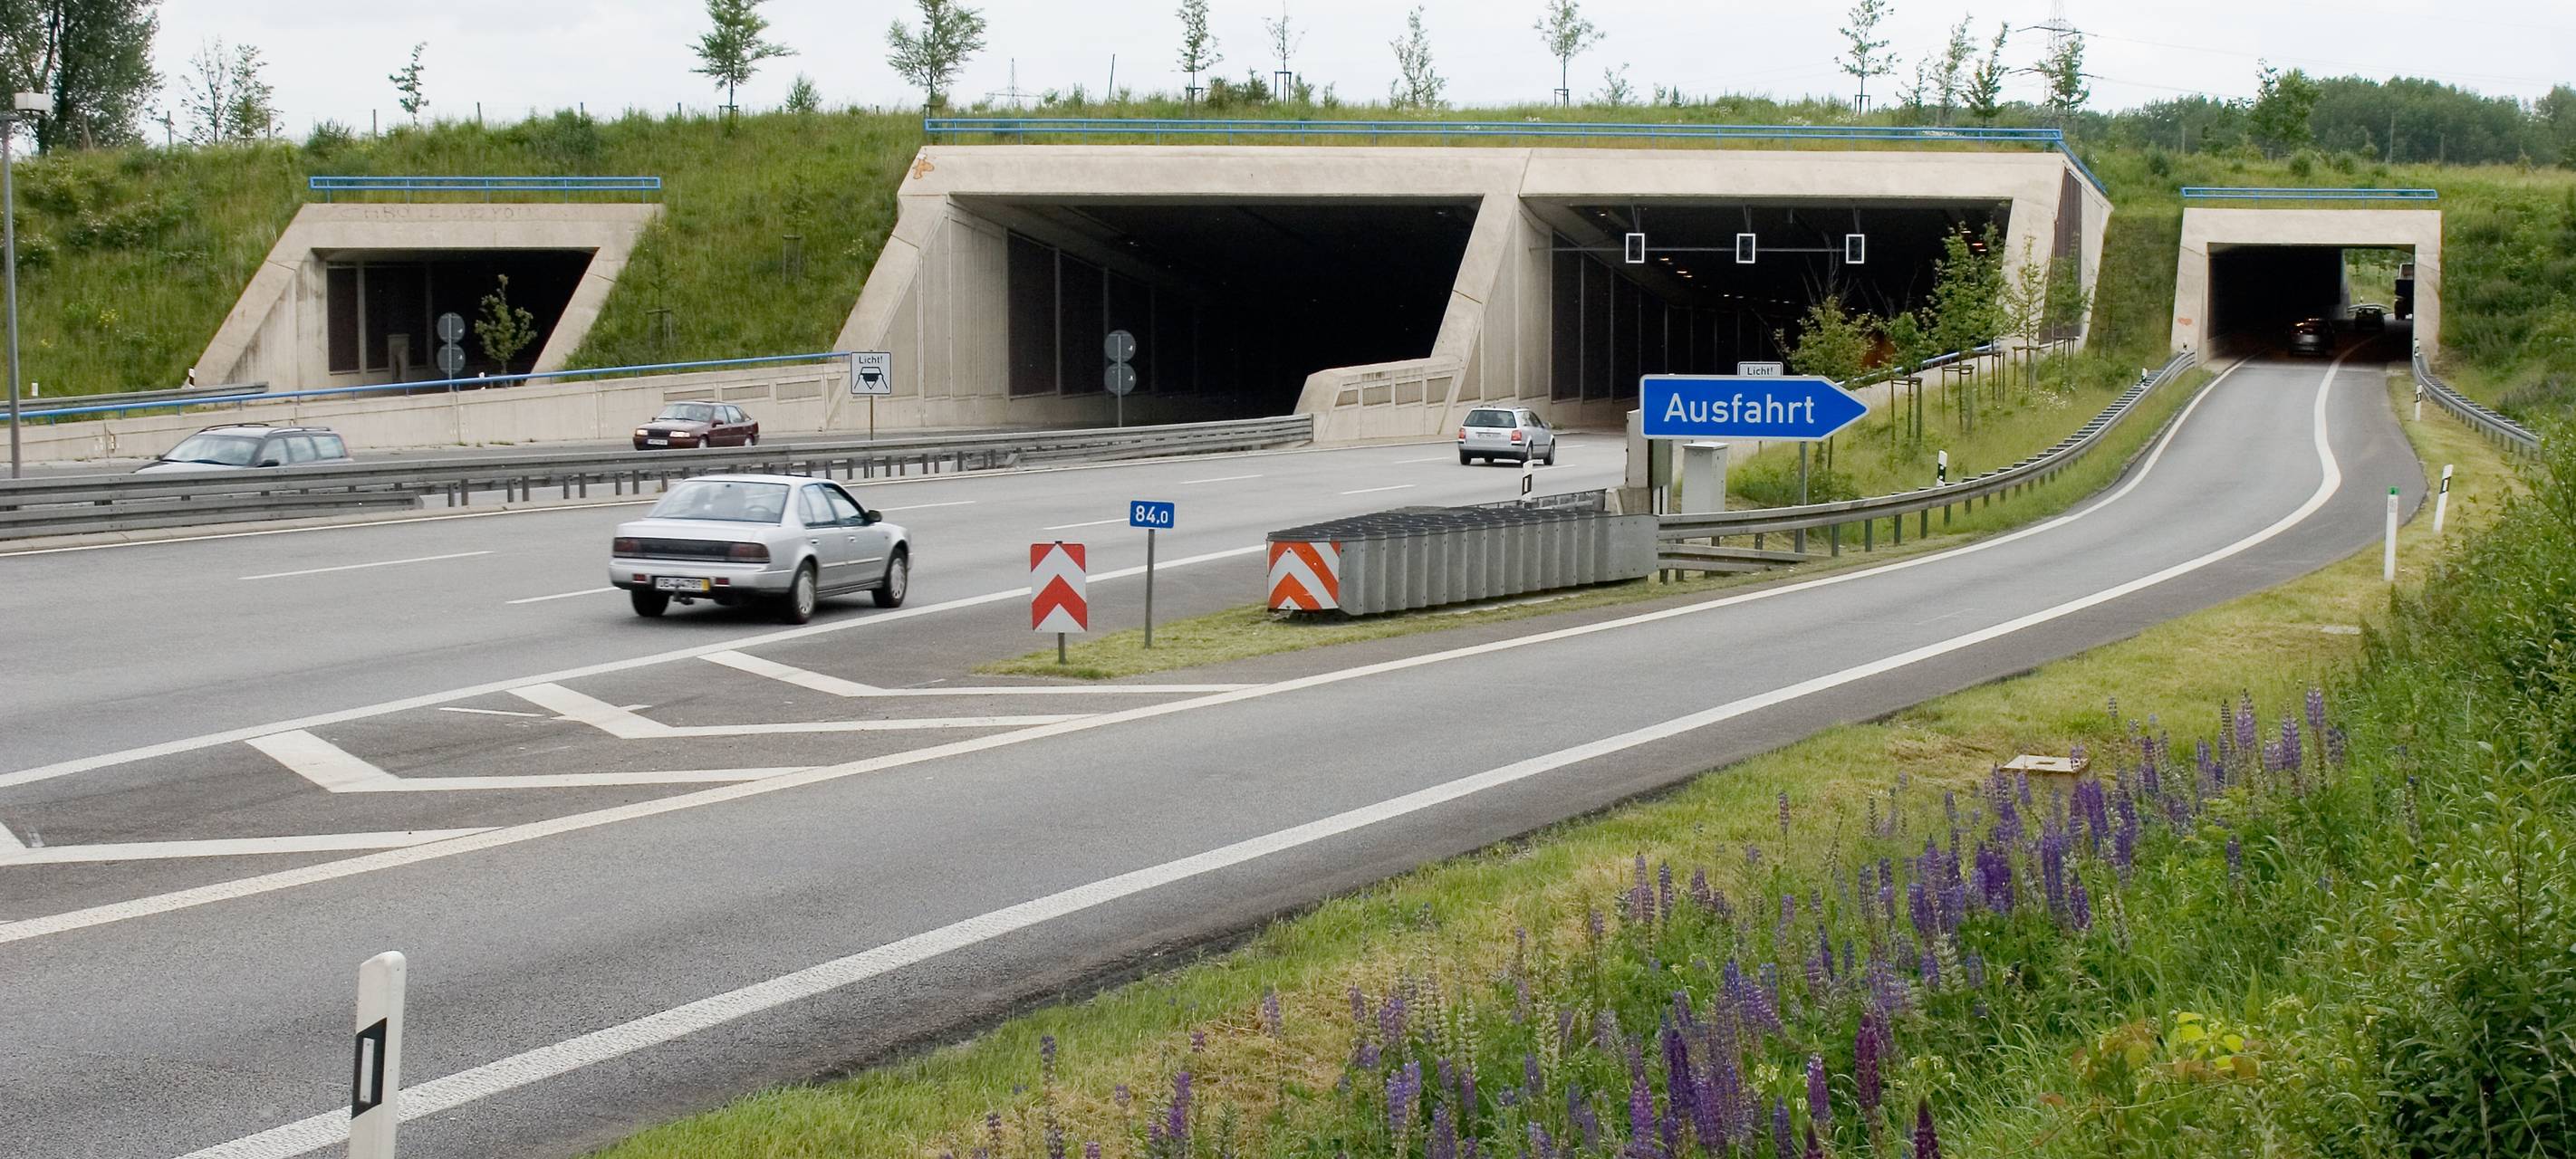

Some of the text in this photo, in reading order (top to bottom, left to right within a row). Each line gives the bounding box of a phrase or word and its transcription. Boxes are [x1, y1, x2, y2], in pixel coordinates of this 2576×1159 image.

[859, 356, 883, 364] Licht!
[1747, 366, 1773, 376] Licht!
[1663, 392, 1815, 425] Ausfahrt
[1135, 504, 1168, 525] 84,0
